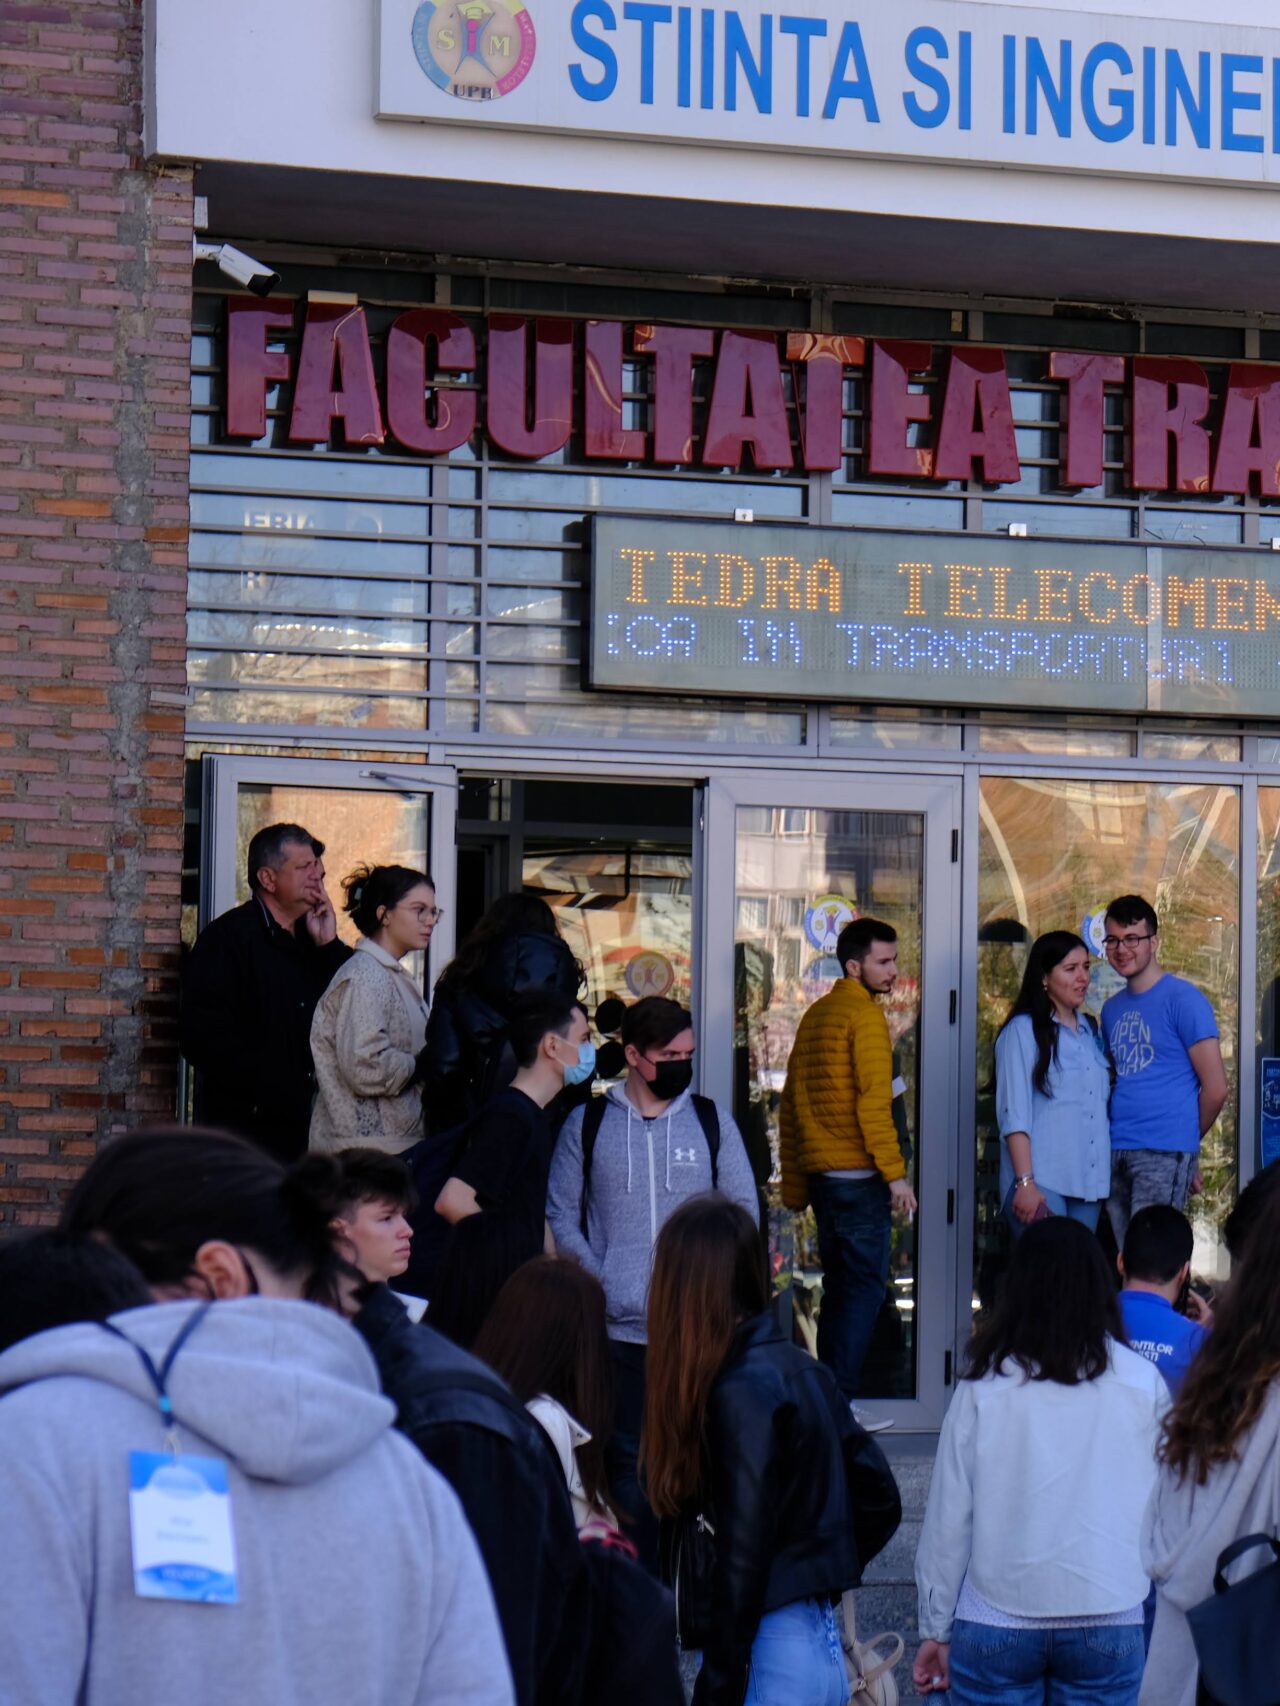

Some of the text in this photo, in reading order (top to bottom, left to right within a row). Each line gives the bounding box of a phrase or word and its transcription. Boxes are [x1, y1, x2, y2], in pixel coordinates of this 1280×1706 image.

[568, 0, 881, 124] STIINTA
[903, 26, 973, 131] SI
[226, 293, 1021, 485] FACULTATEA
[620, 547, 842, 614] TEDRA
[1109, 1017, 1151, 1046] OPEN
[1122, 1010, 1141, 1021] THE
